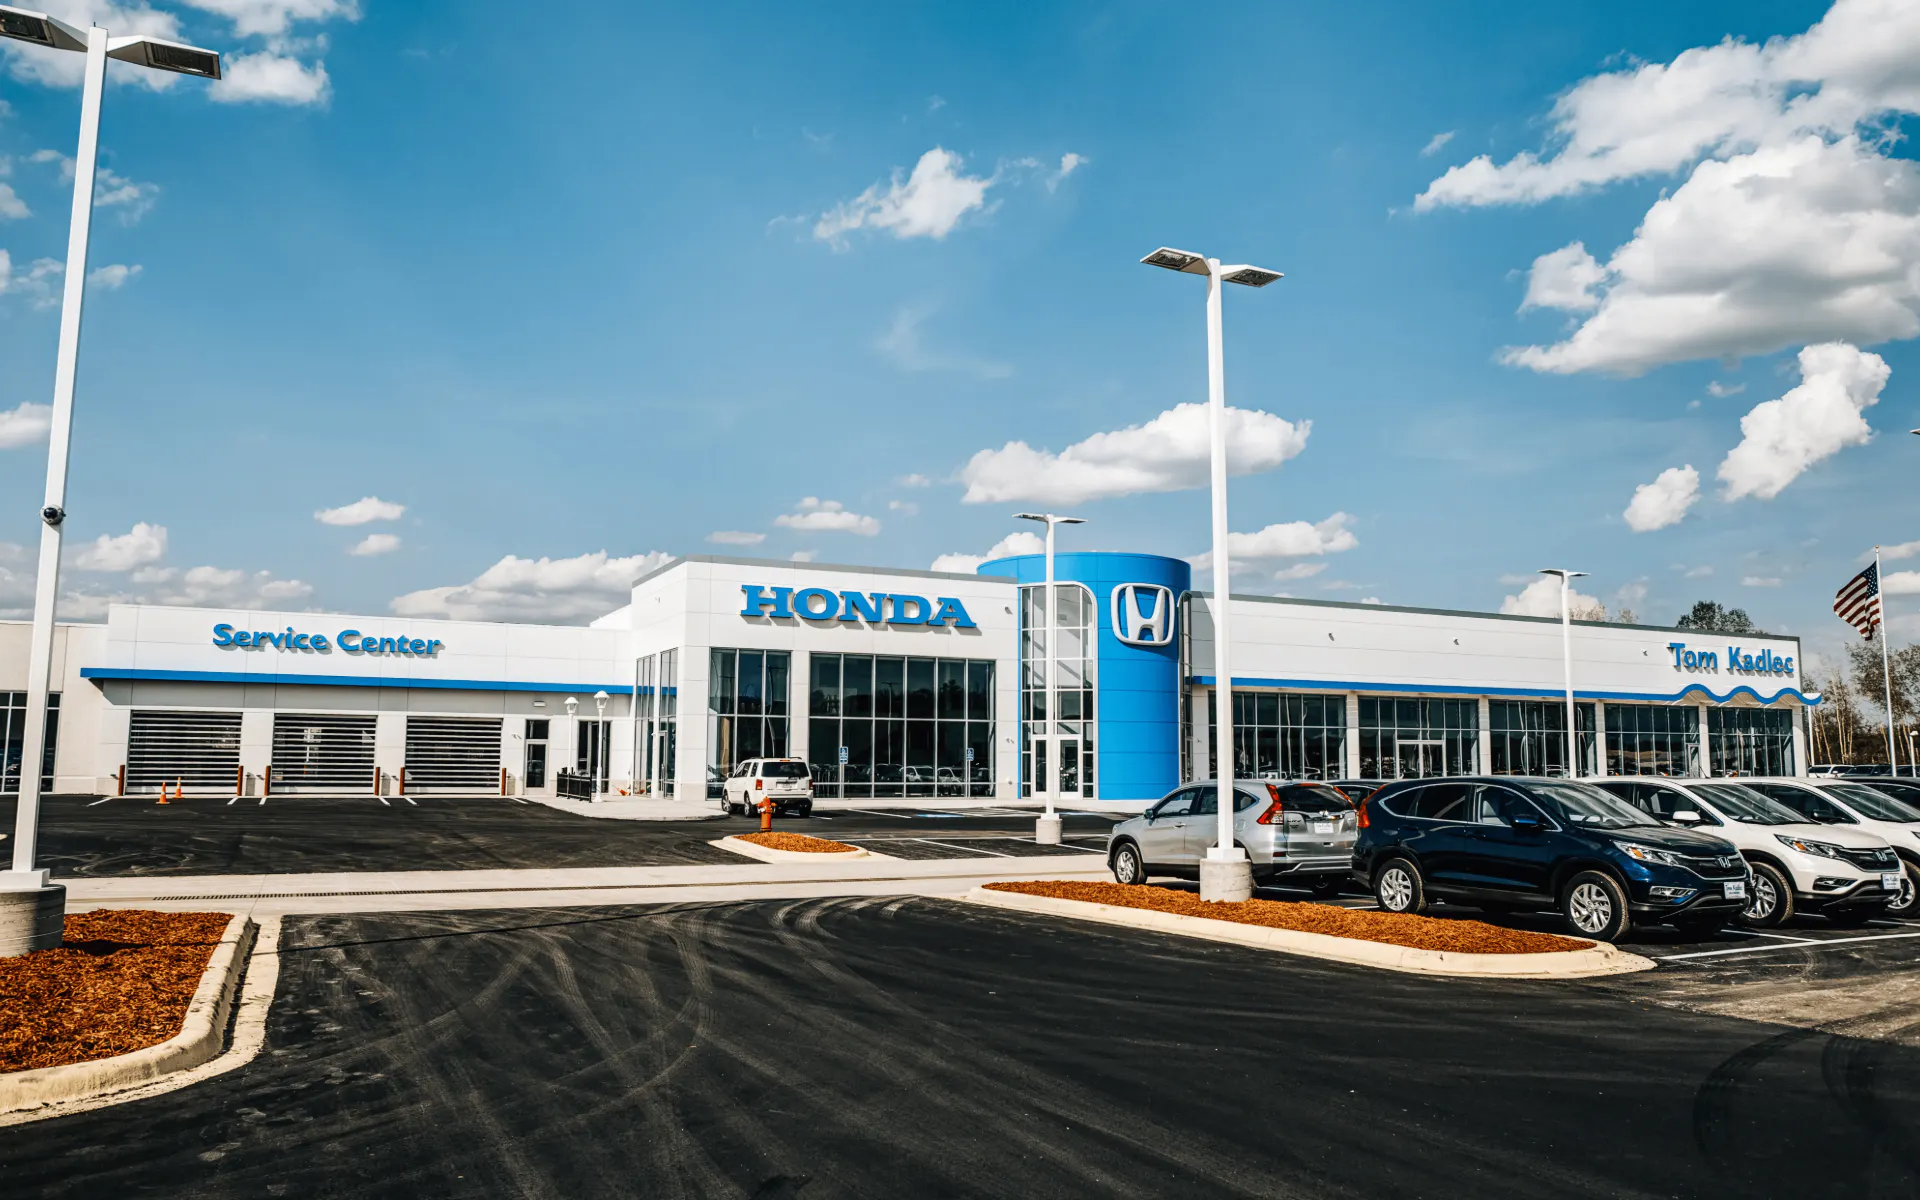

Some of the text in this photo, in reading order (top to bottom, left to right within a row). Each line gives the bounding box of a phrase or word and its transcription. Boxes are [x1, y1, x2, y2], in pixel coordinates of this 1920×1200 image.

[741, 585, 976, 627] HONDA
[213, 624, 440, 654] Service Center
[1670, 643, 1794, 672] Tom Kadlec
